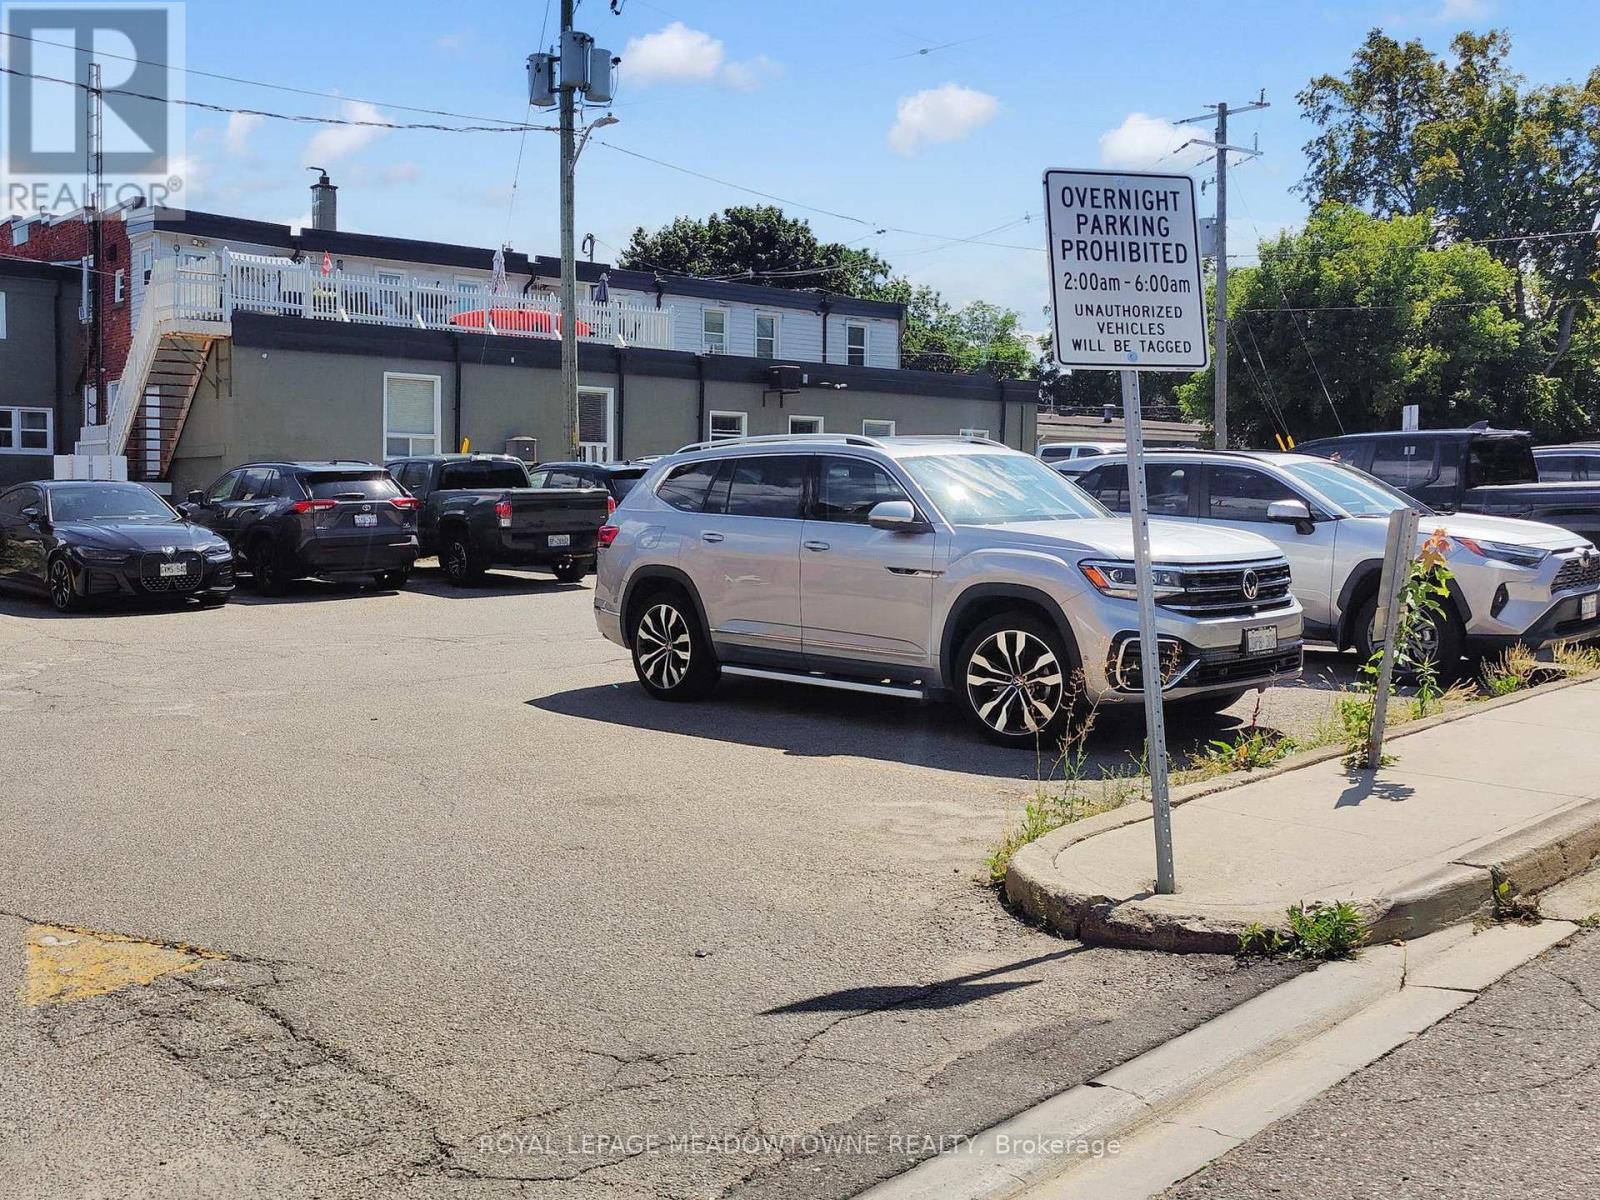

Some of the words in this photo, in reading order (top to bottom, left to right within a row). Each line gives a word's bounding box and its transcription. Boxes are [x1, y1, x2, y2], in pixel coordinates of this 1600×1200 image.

[1061, 186, 1180, 212] OVERNIGHT
[1076, 214, 1170, 237] PARKING
[1061, 240, 1188, 263] PROHIBITED
[1074, 304, 1183, 318] UNAUTHORIZED
[1097, 322, 1165, 335] VEHICLES
[1071, 339, 1105, 351] WILL
[1113, 340, 1131, 352] BE
[1139, 341, 1192, 353] TAGGED
